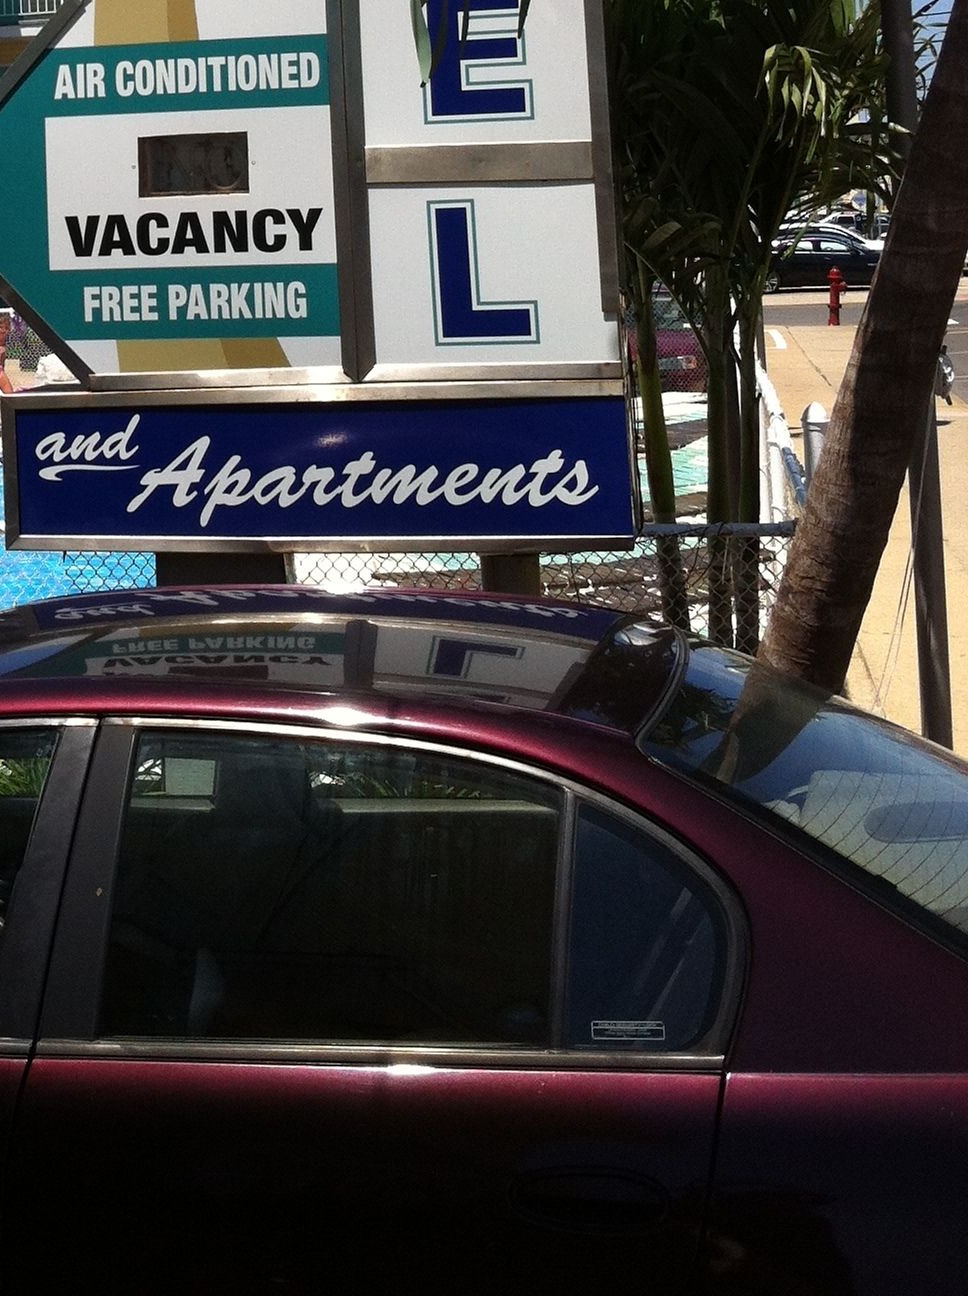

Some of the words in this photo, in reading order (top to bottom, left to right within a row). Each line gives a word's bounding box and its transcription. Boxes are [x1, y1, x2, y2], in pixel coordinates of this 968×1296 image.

[53, 62, 106, 100] AIR
[114, 52, 321, 98] CONDITIONED
[64, 208, 324, 258] VACANCY
[83, 284, 159, 323] FREE
[167, 281, 308, 321] PARKING
[35, 413, 140, 464] and
[127, 435, 600, 527] Apartments
